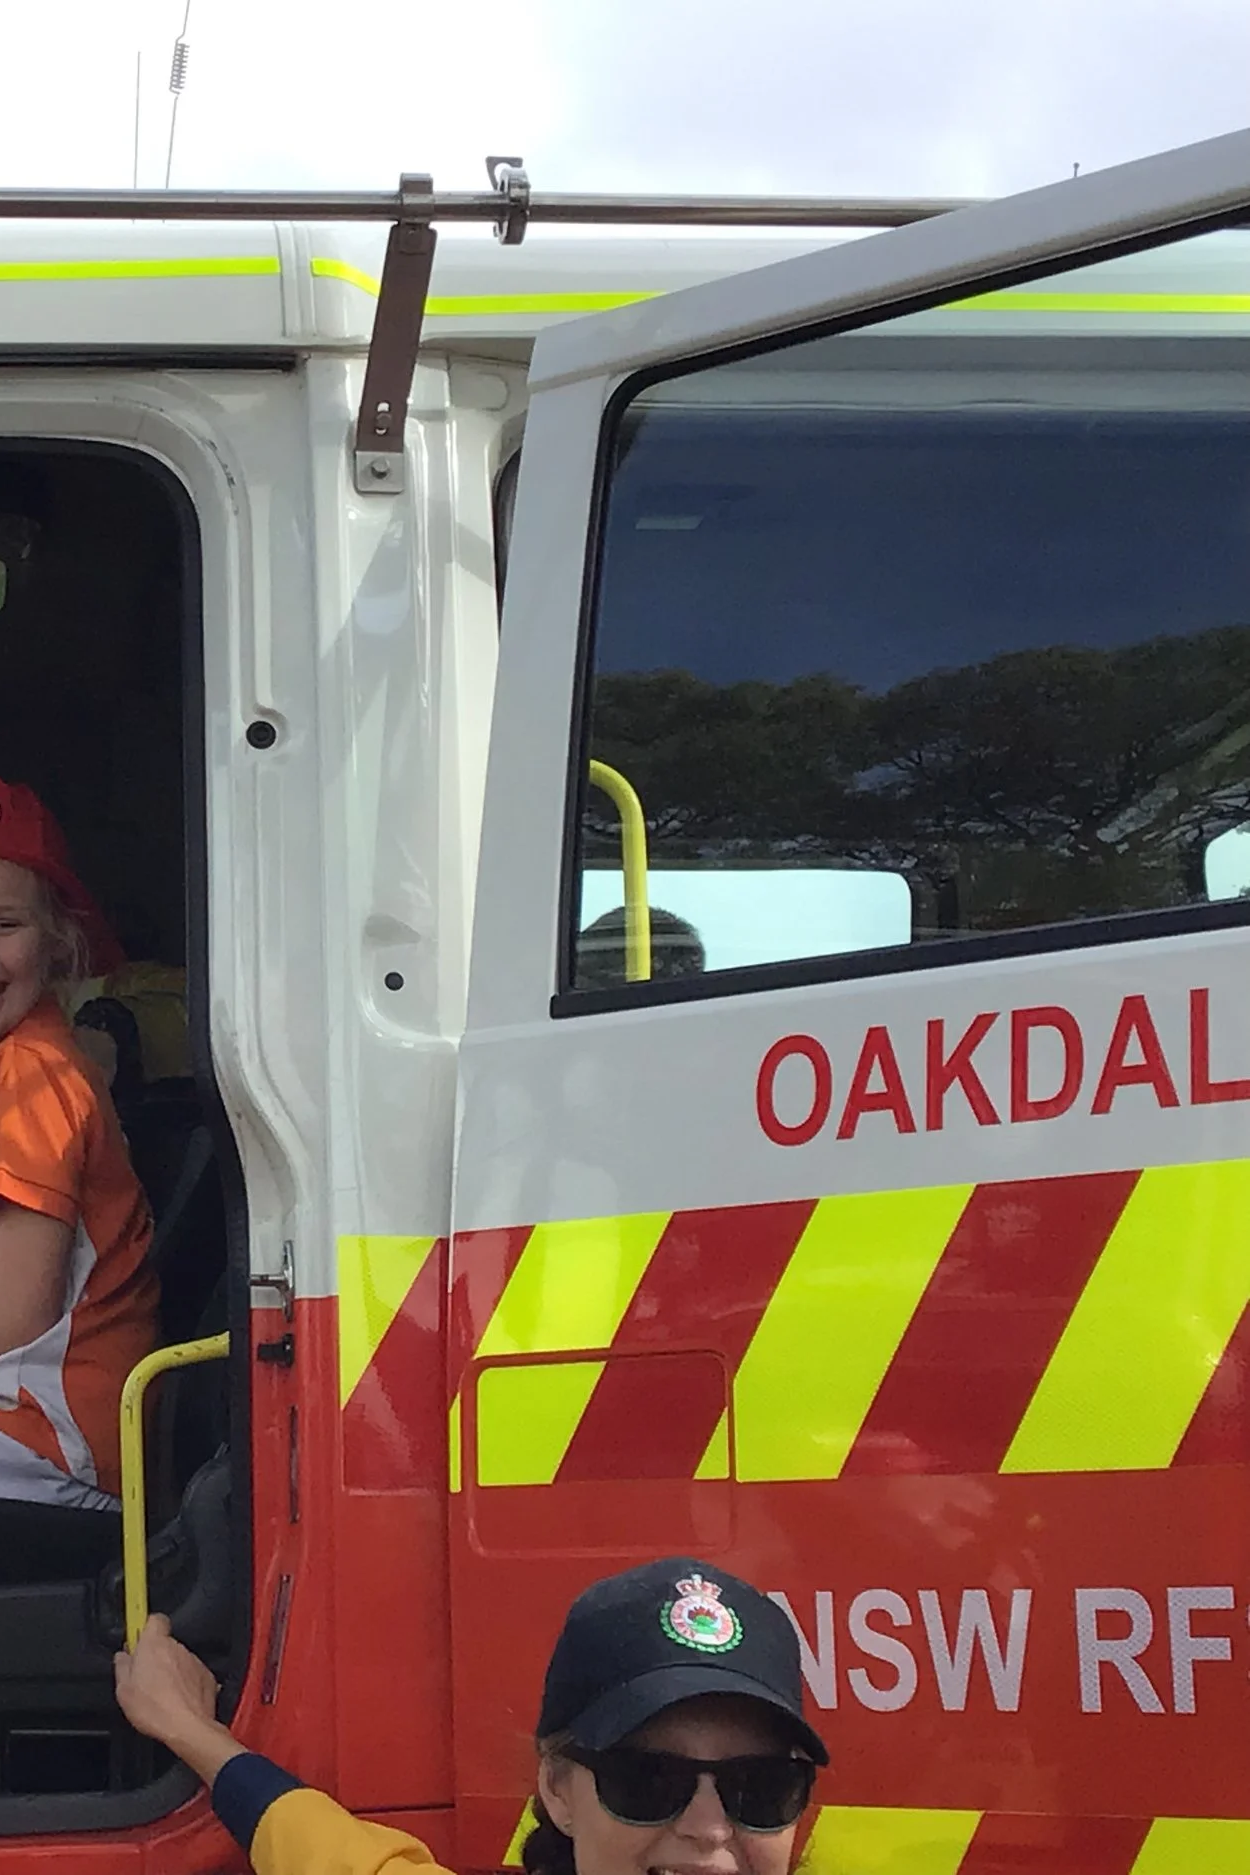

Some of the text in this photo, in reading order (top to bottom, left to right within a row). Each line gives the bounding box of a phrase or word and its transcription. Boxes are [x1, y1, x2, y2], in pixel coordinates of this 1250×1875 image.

[756, 988, 1250, 1146] OAKDAL
[766, 1586, 1250, 1714] NSW RF
